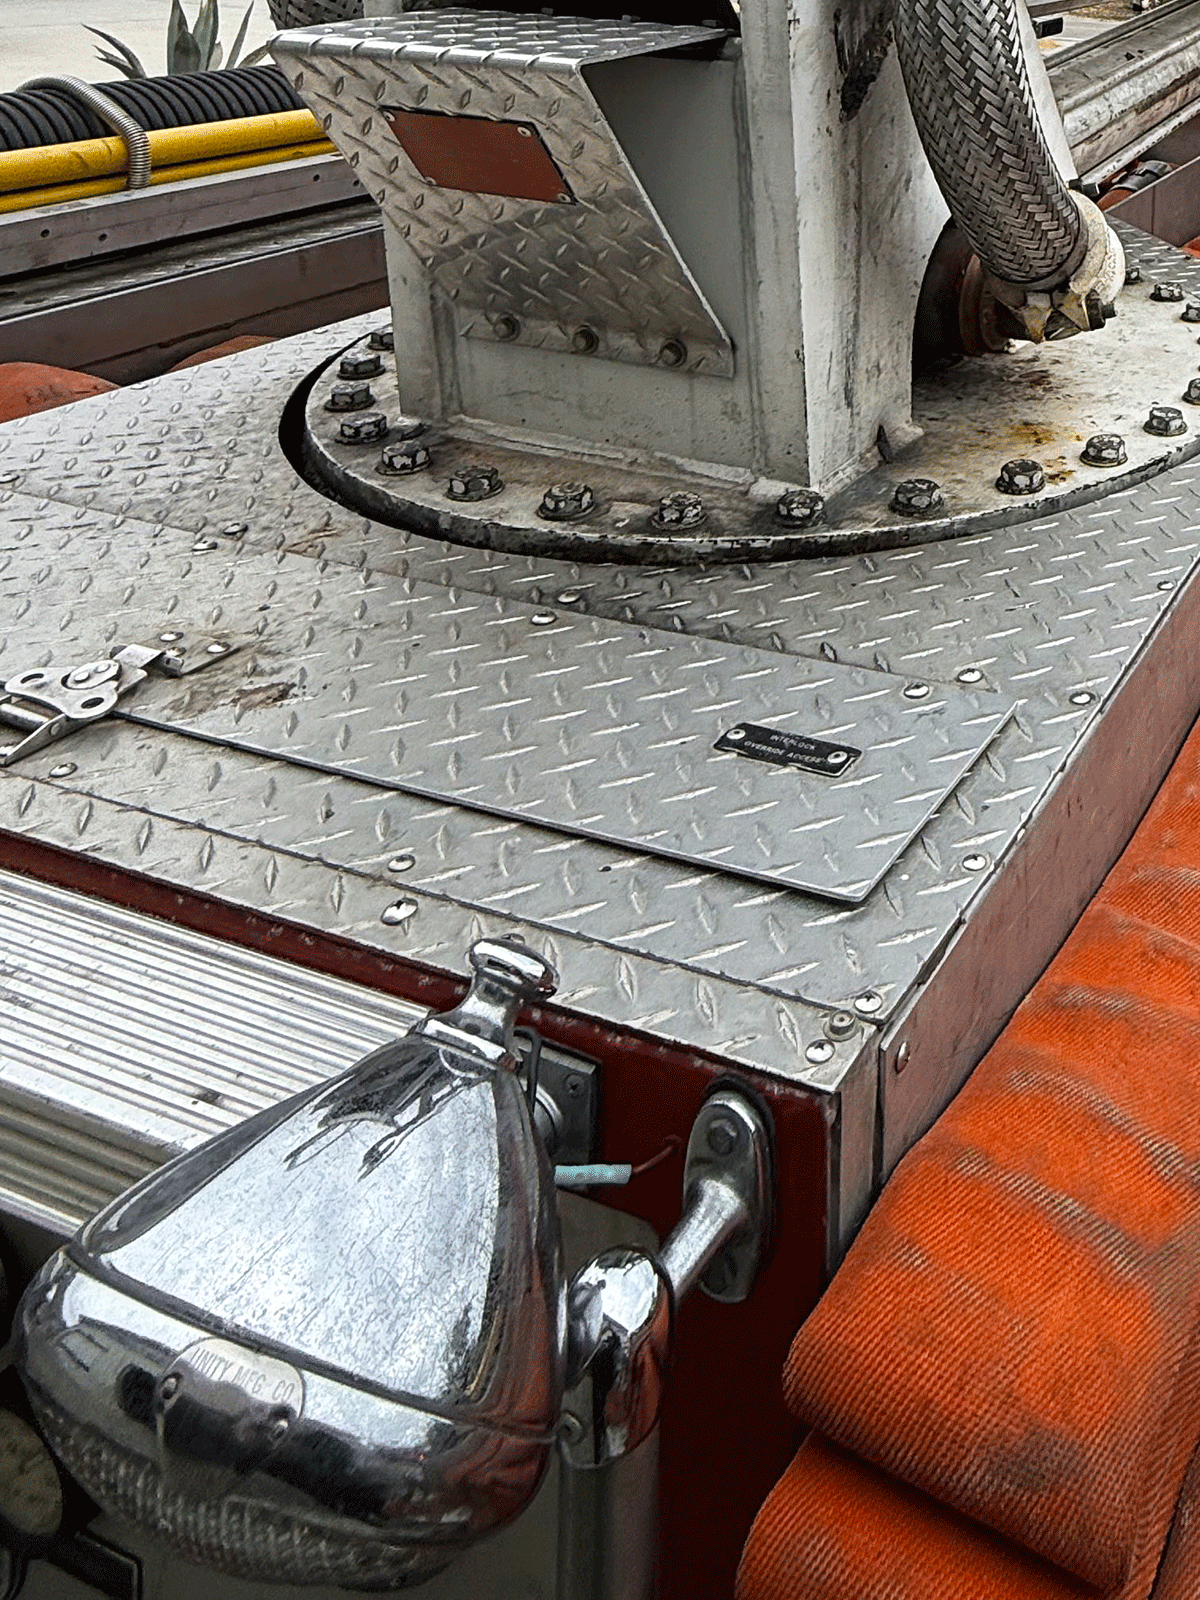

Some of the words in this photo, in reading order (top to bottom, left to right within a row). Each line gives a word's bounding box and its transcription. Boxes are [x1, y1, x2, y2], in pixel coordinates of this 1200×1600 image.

[744, 740, 787, 756] OVERRIDE
[769, 734, 817, 751] INTERLOCK
[190, 1346, 235, 1381] UNITY
[230, 1365, 266, 1395] MFG
